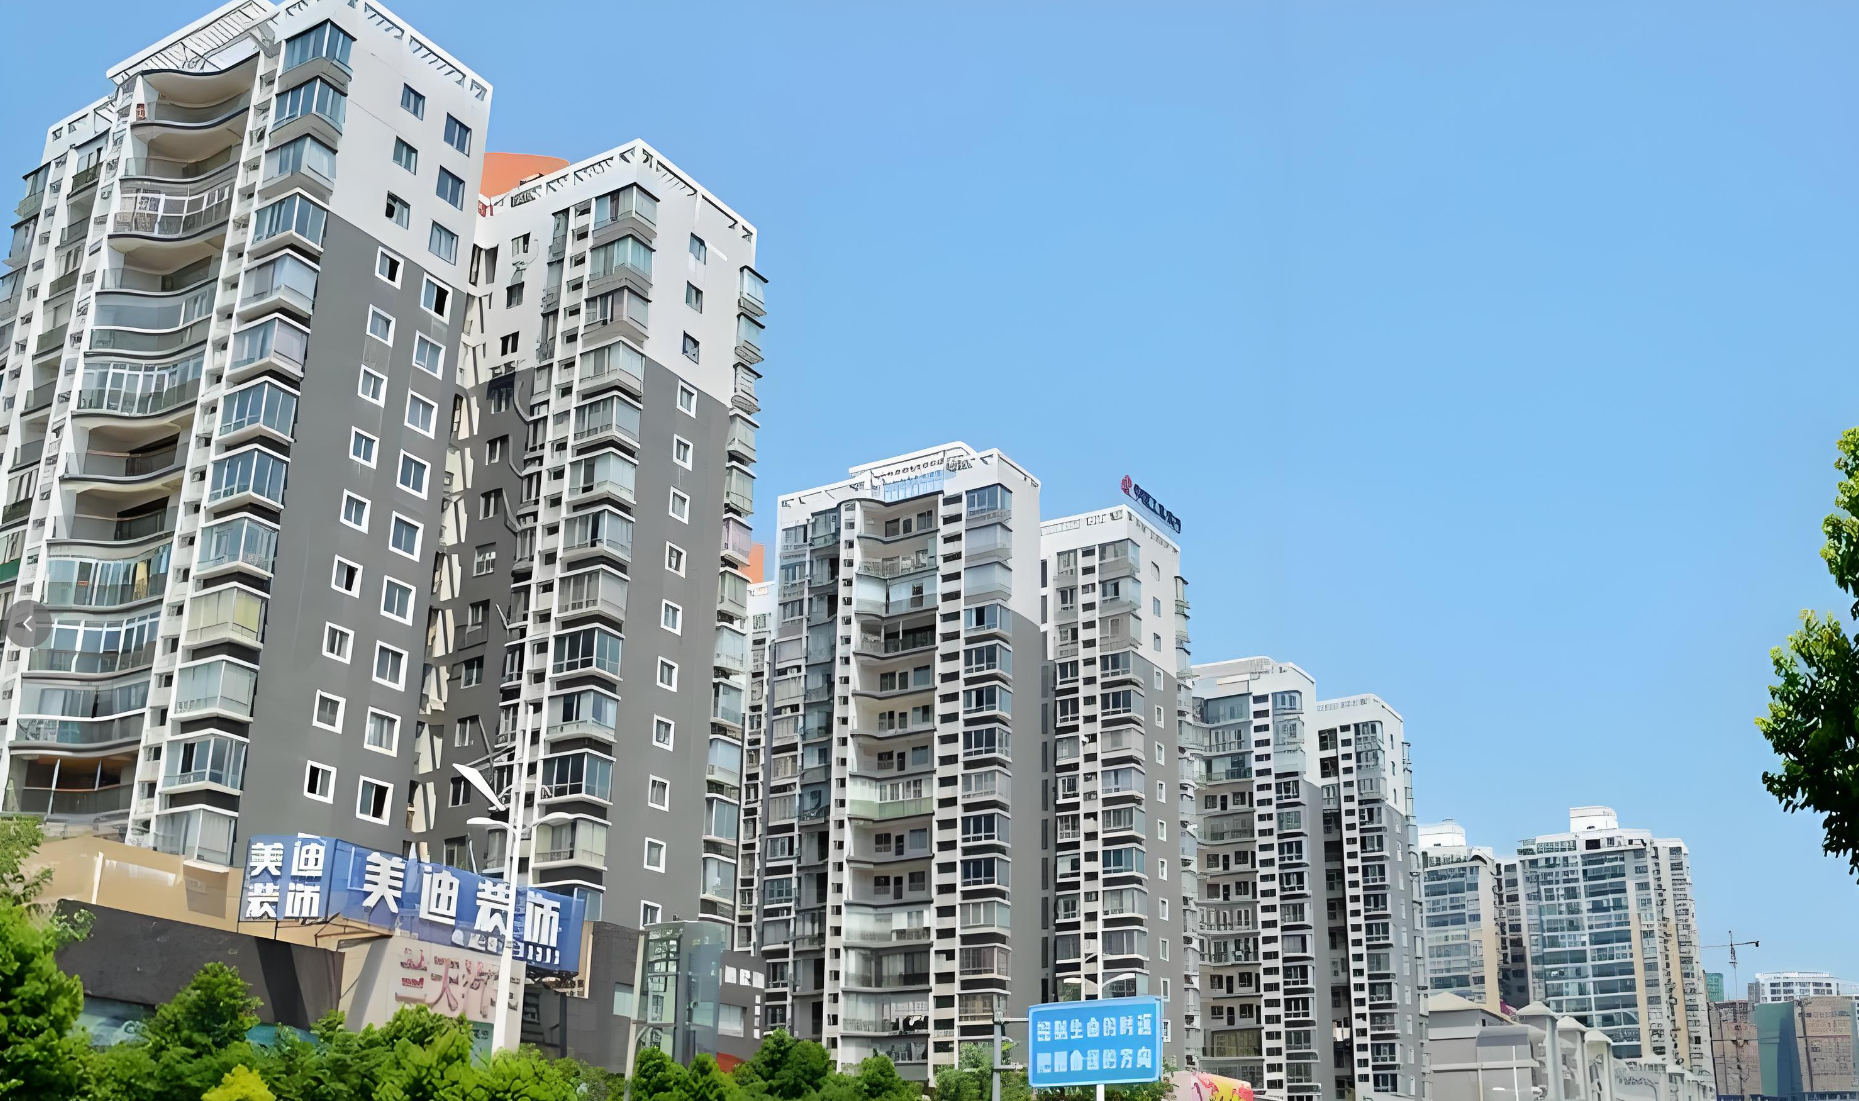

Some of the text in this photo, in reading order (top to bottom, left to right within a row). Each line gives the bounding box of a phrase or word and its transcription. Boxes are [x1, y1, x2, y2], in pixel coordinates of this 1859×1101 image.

[250, 841, 326, 877] 美迪
[245, 881, 321, 918] 装饰
[362, 851, 561, 948] 美迪装饰
